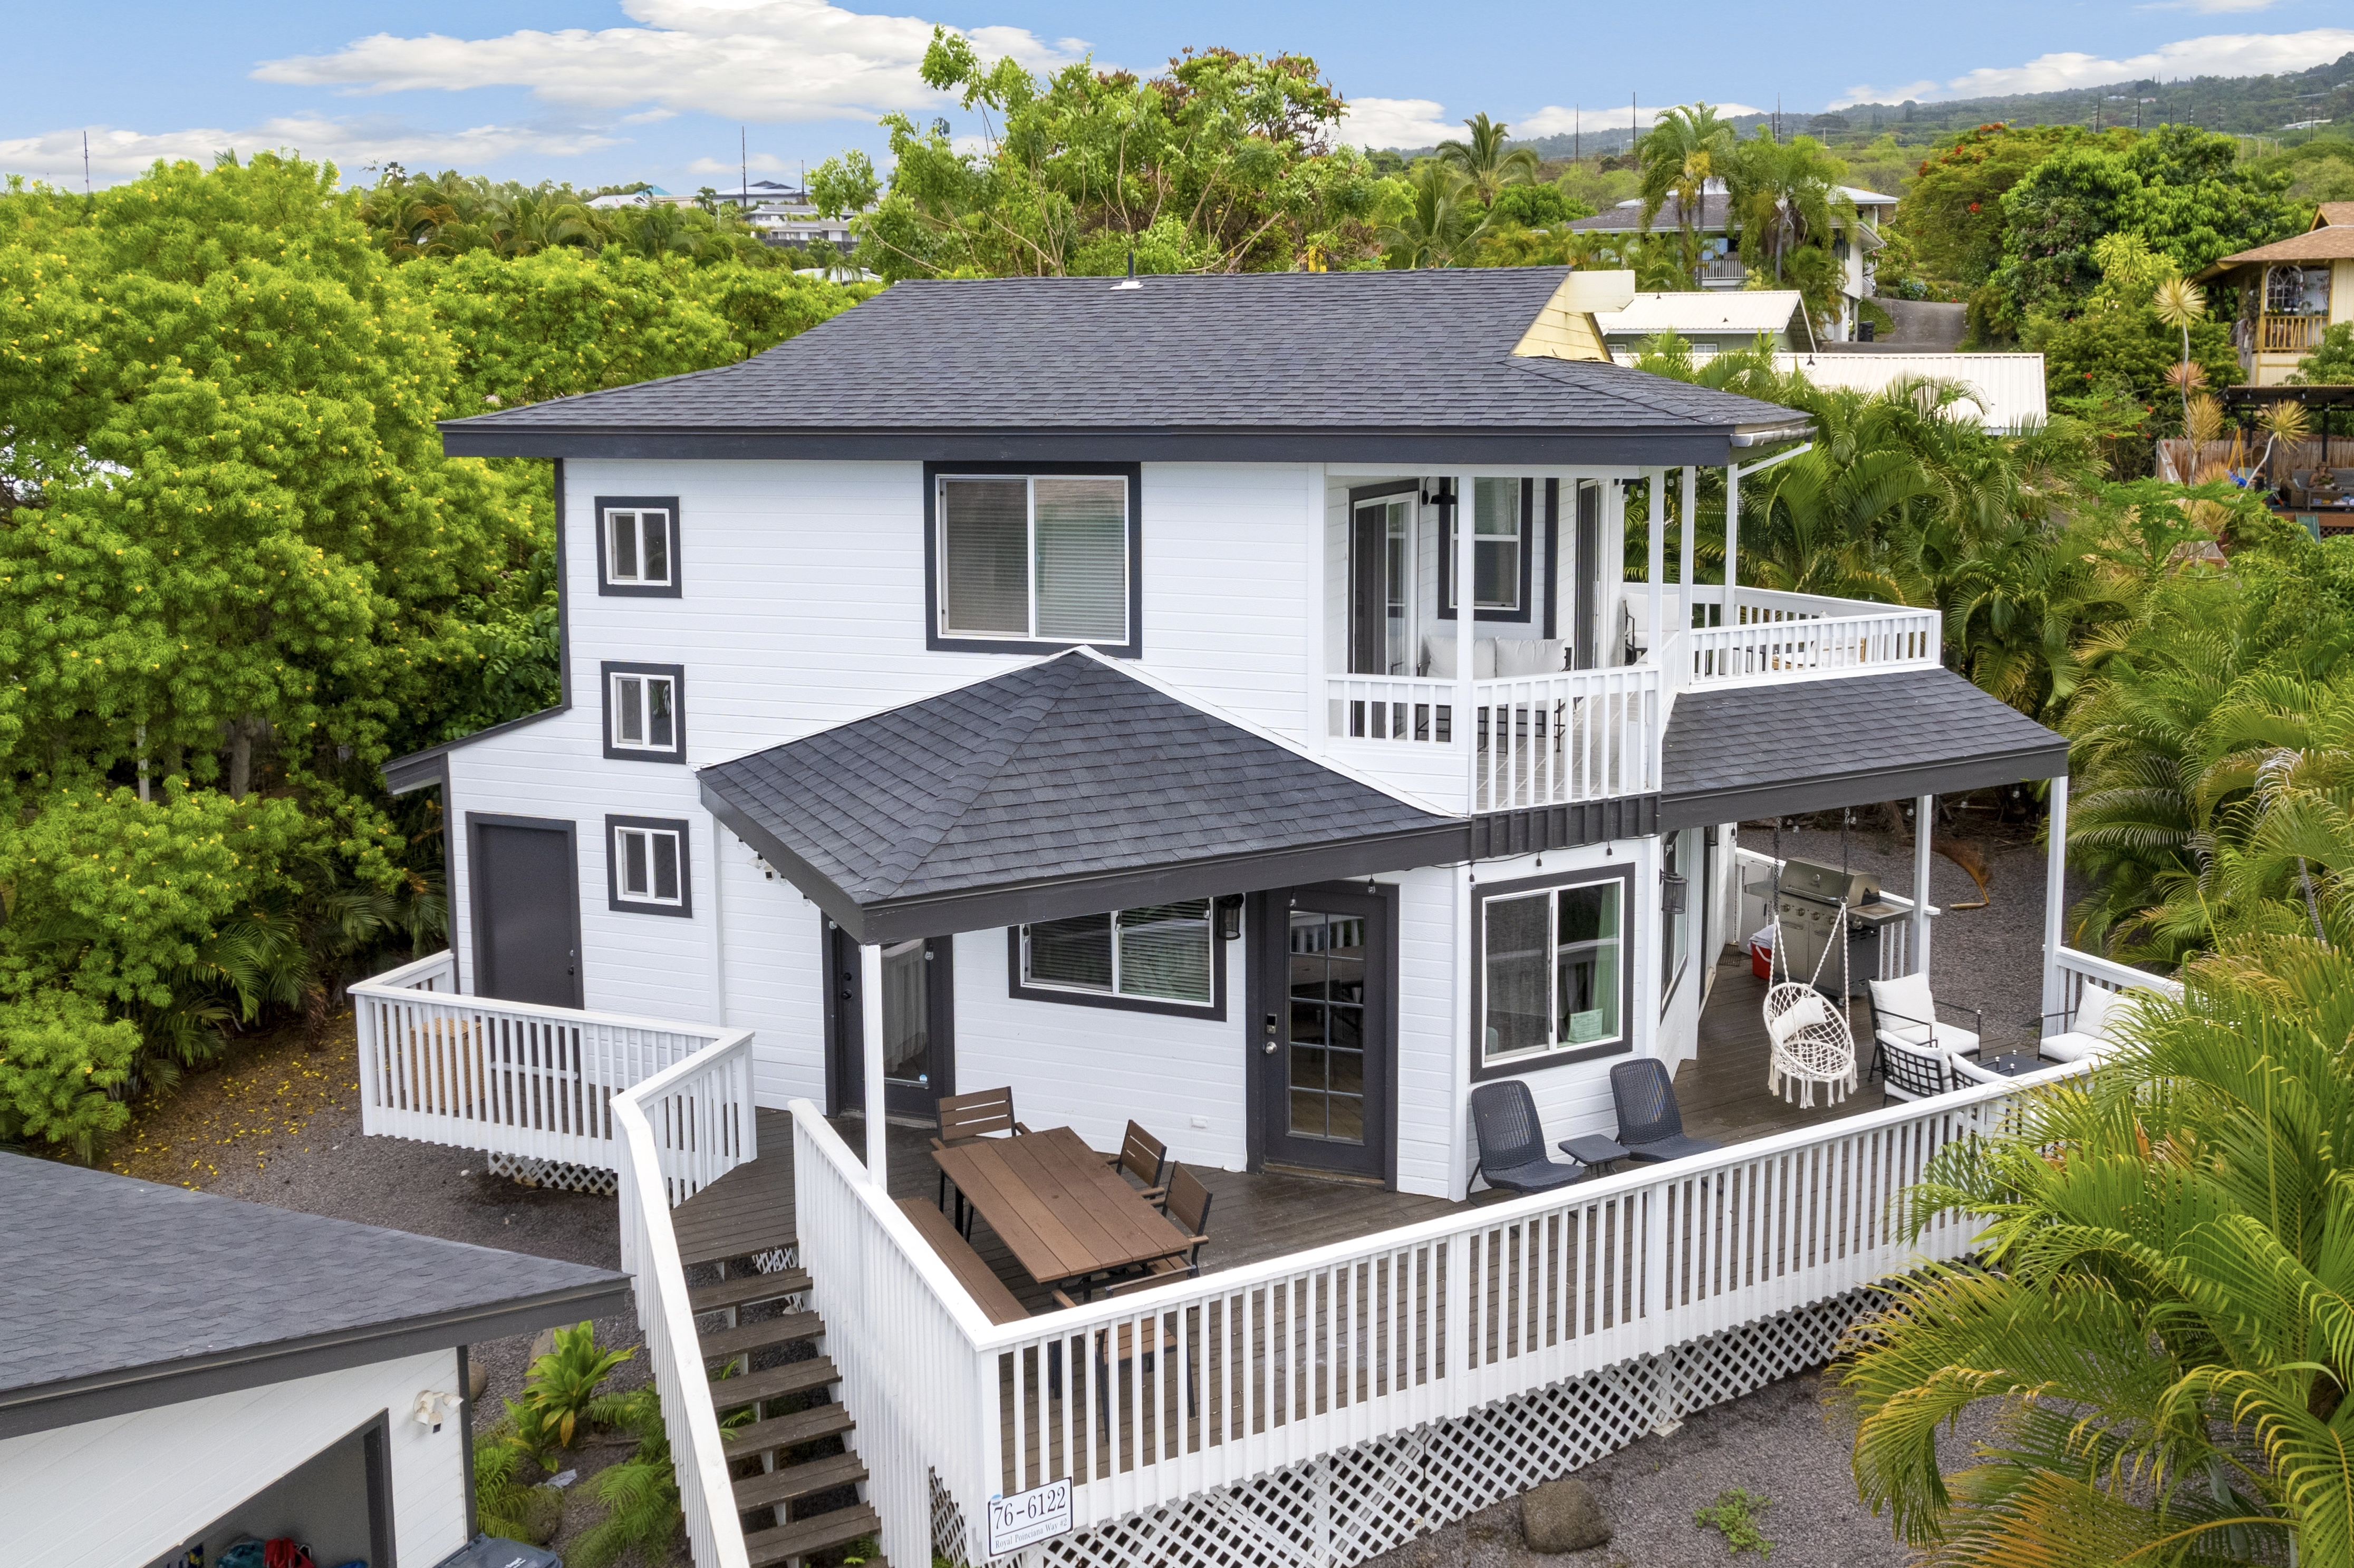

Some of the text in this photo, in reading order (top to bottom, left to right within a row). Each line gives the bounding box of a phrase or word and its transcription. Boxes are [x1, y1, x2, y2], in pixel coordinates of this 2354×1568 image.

[994, 1486, 1066, 1530] 76-6122
[996, 1518, 1067, 1550] Royal Poinciana Way #2
